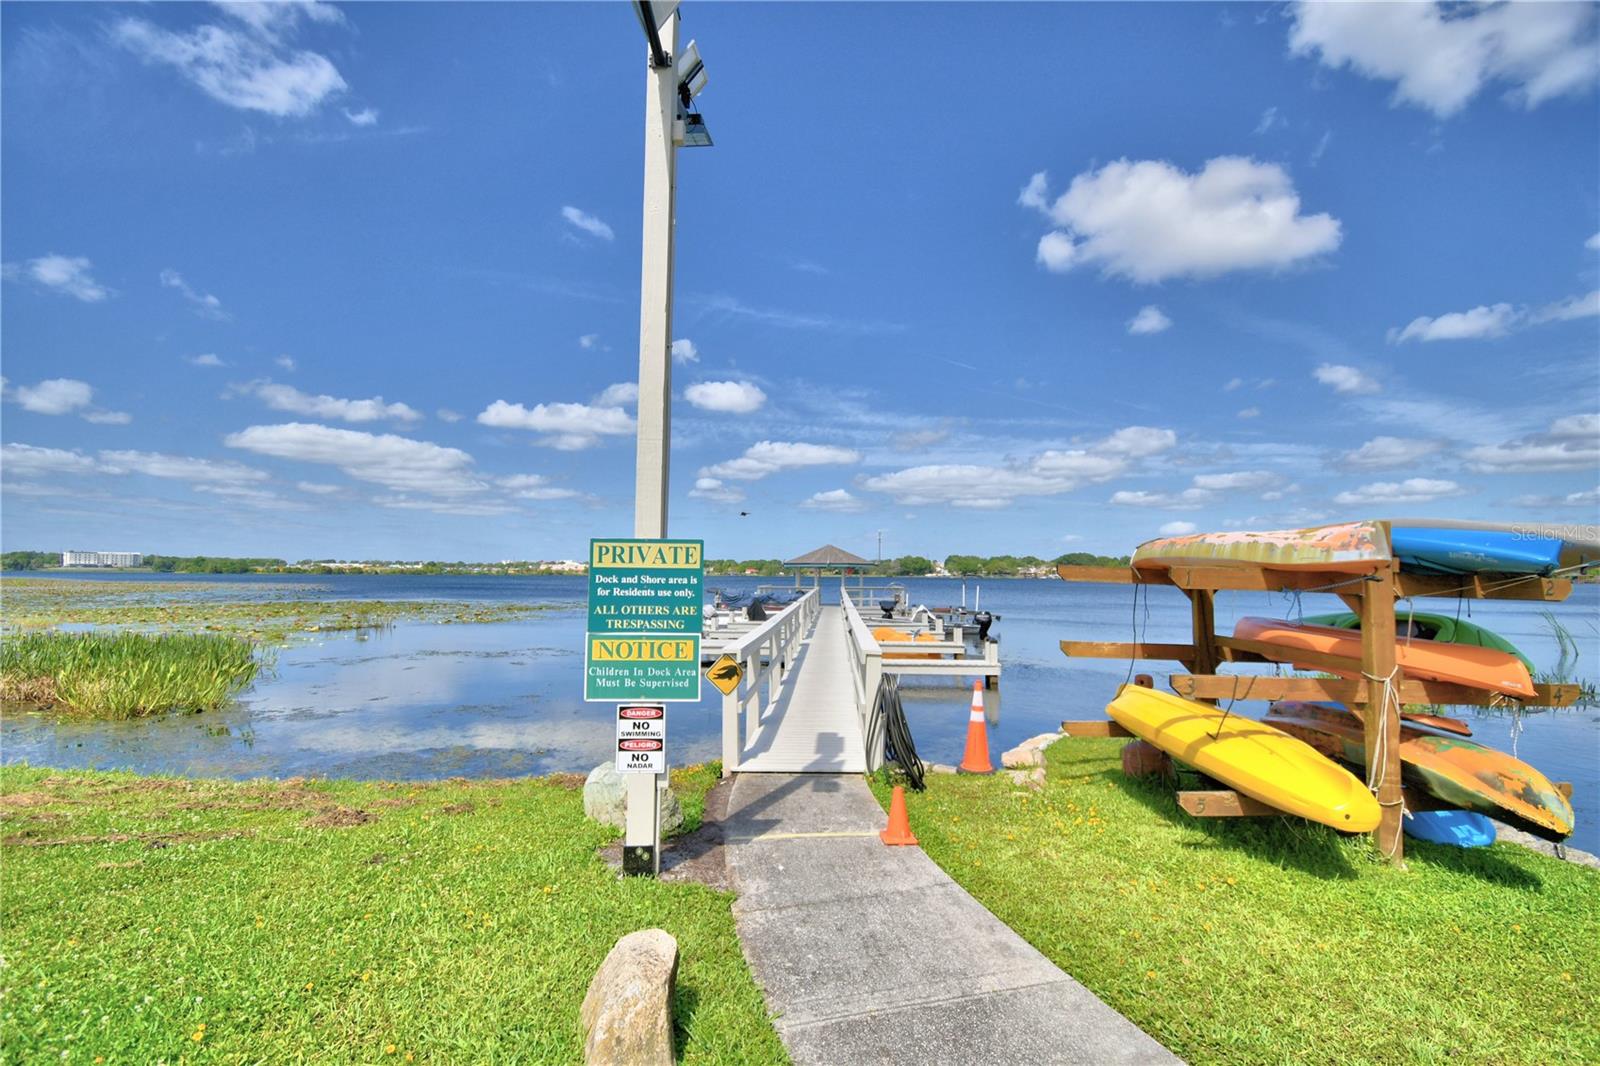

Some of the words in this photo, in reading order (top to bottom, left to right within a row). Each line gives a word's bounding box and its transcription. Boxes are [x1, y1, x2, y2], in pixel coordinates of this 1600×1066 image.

[597, 545, 698, 565] PRIVATE
[595, 575, 619, 584] Dock
[621, 575, 638, 584] and
[640, 575, 666, 585] Shore
[668, 576, 688, 585] area
[690, 576, 698, 585] is
[597, 587, 610, 597] for
[613, 587, 655, 597] Residents
[657, 589, 672, 597] use
[674, 588, 695, 599] only.
[1545, 580, 1556, 596] 2
[594, 605, 618, 615] ALL
[621, 605, 670, 616] OTHERS
[672, 606, 698, 616] ARE
[606, 619, 685, 630] TRESPASSING
[598, 641, 689, 660] NOTICE
[588, 666, 630, 676] Children
[633, 666, 644, 676] In
[647, 667, 671, 676] Dock
[674, 667, 697, 677] Area
[596, 678, 620, 688] Must
[624, 679, 637, 688] Be
[639, 678, 690, 689] Supervised
[1184, 677, 1195, 696] 3
[1554, 687, 1562, 705] 4
[632, 721, 651, 731] NO
[631, 753, 650, 763] NO
